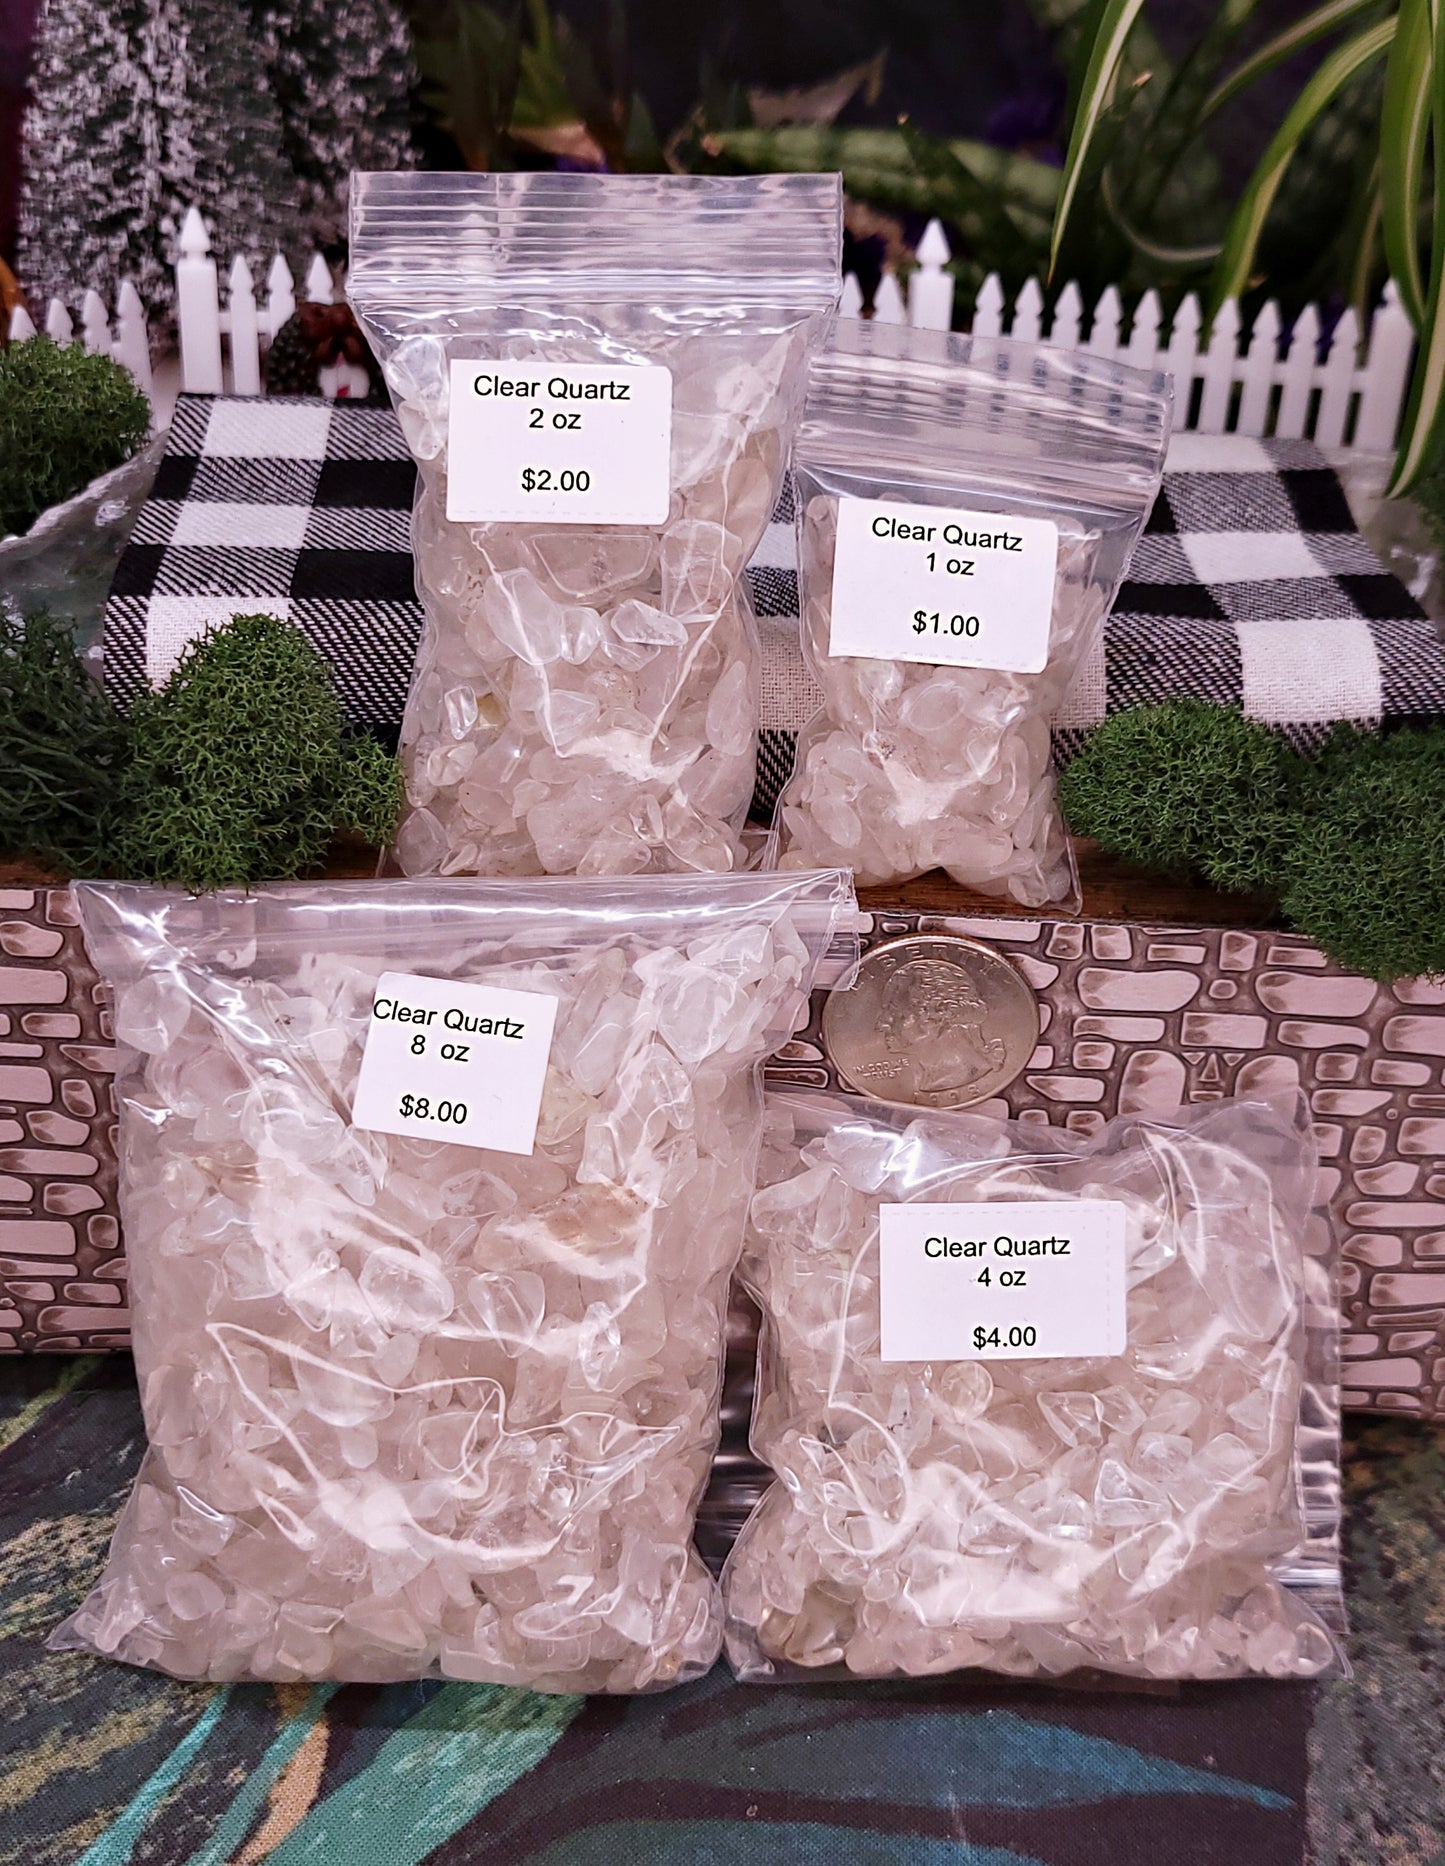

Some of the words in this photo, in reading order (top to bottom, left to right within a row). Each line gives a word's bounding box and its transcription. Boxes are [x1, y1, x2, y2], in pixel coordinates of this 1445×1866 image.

[474, 375, 541, 399] Clear
[547, 377, 631, 400] Quartz
[528, 407, 544, 429] 2
[552, 413, 582, 430] oz
[521, 467, 590, 493] $2.00
[872, 517, 937, 542] Clear
[943, 524, 1023, 552] Quartz
[926, 552, 936, 572] 1
[946, 559, 975, 576] oz
[912, 610, 980, 637] $1.00
[373, 999, 438, 1026] Clear
[443, 1008, 525, 1040] Quartz
[410, 1034, 426, 1055] 8
[440, 1043, 470, 1062] oz
[399, 1094, 468, 1125] $8.00
[924, 1236, 988, 1258] Clear
[993, 1236, 1071, 1258] Quartz
[977, 1266, 992, 1287] 4
[999, 1271, 1027, 1287] oz
[973, 1326, 1037, 1351] $4.00
